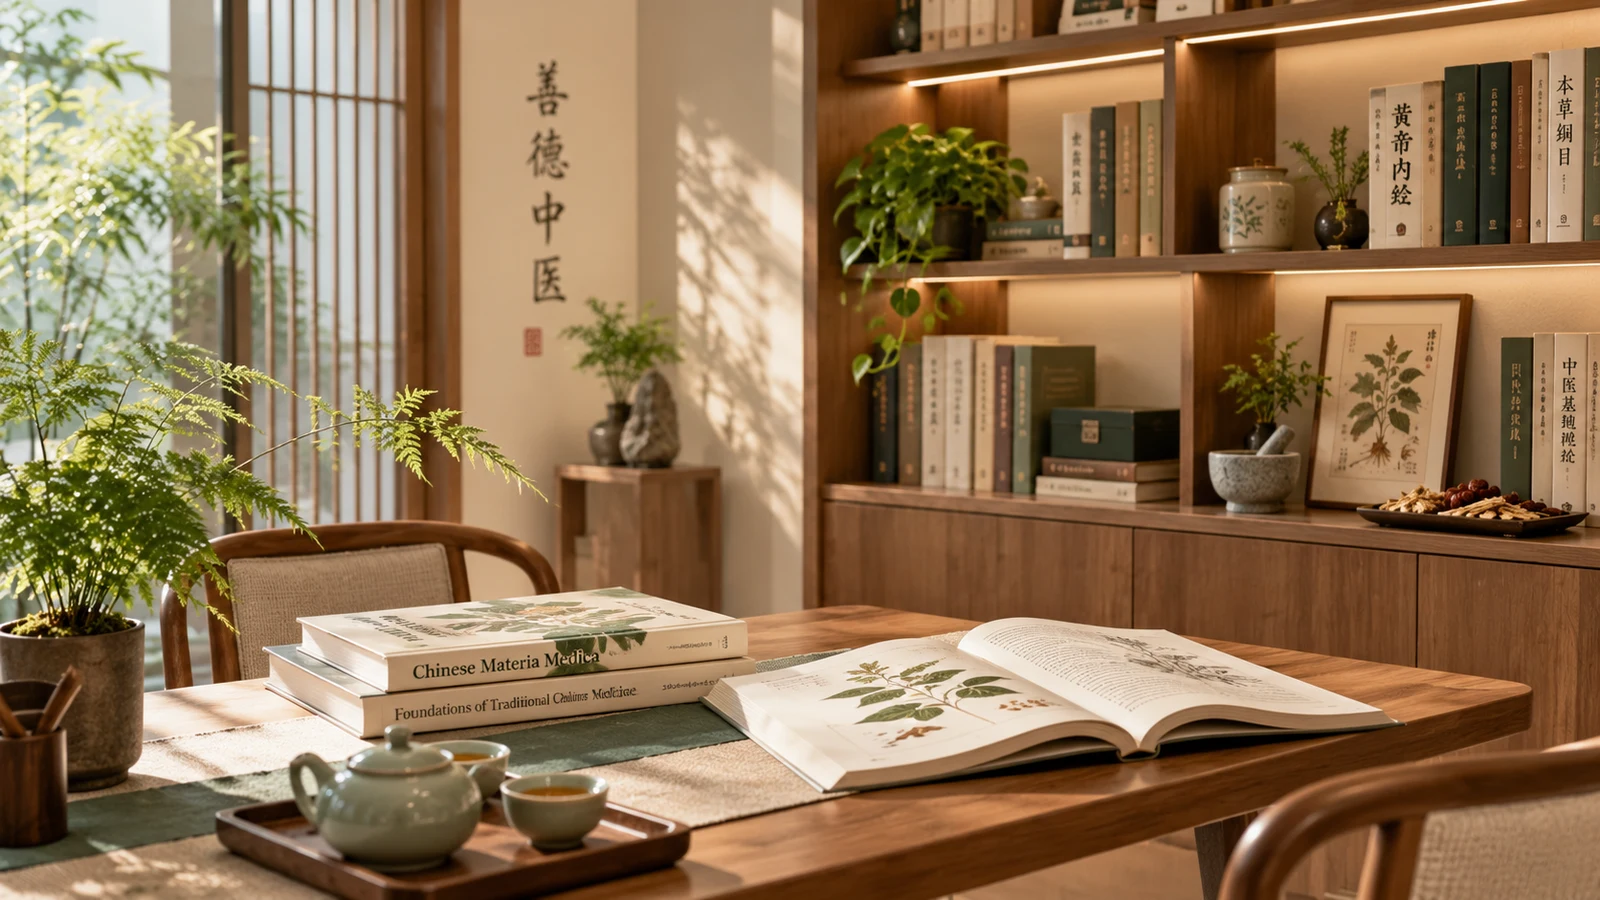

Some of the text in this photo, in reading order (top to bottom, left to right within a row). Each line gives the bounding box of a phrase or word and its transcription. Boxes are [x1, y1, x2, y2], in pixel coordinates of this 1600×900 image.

[1556, 74, 1574, 166] 本草纲目
[526, 59, 569, 303] 善德中医
[412, 649, 600, 680] Chinese Materia Medica
[394, 701, 472, 721] Foundations
[474, 699, 490, 712] of
